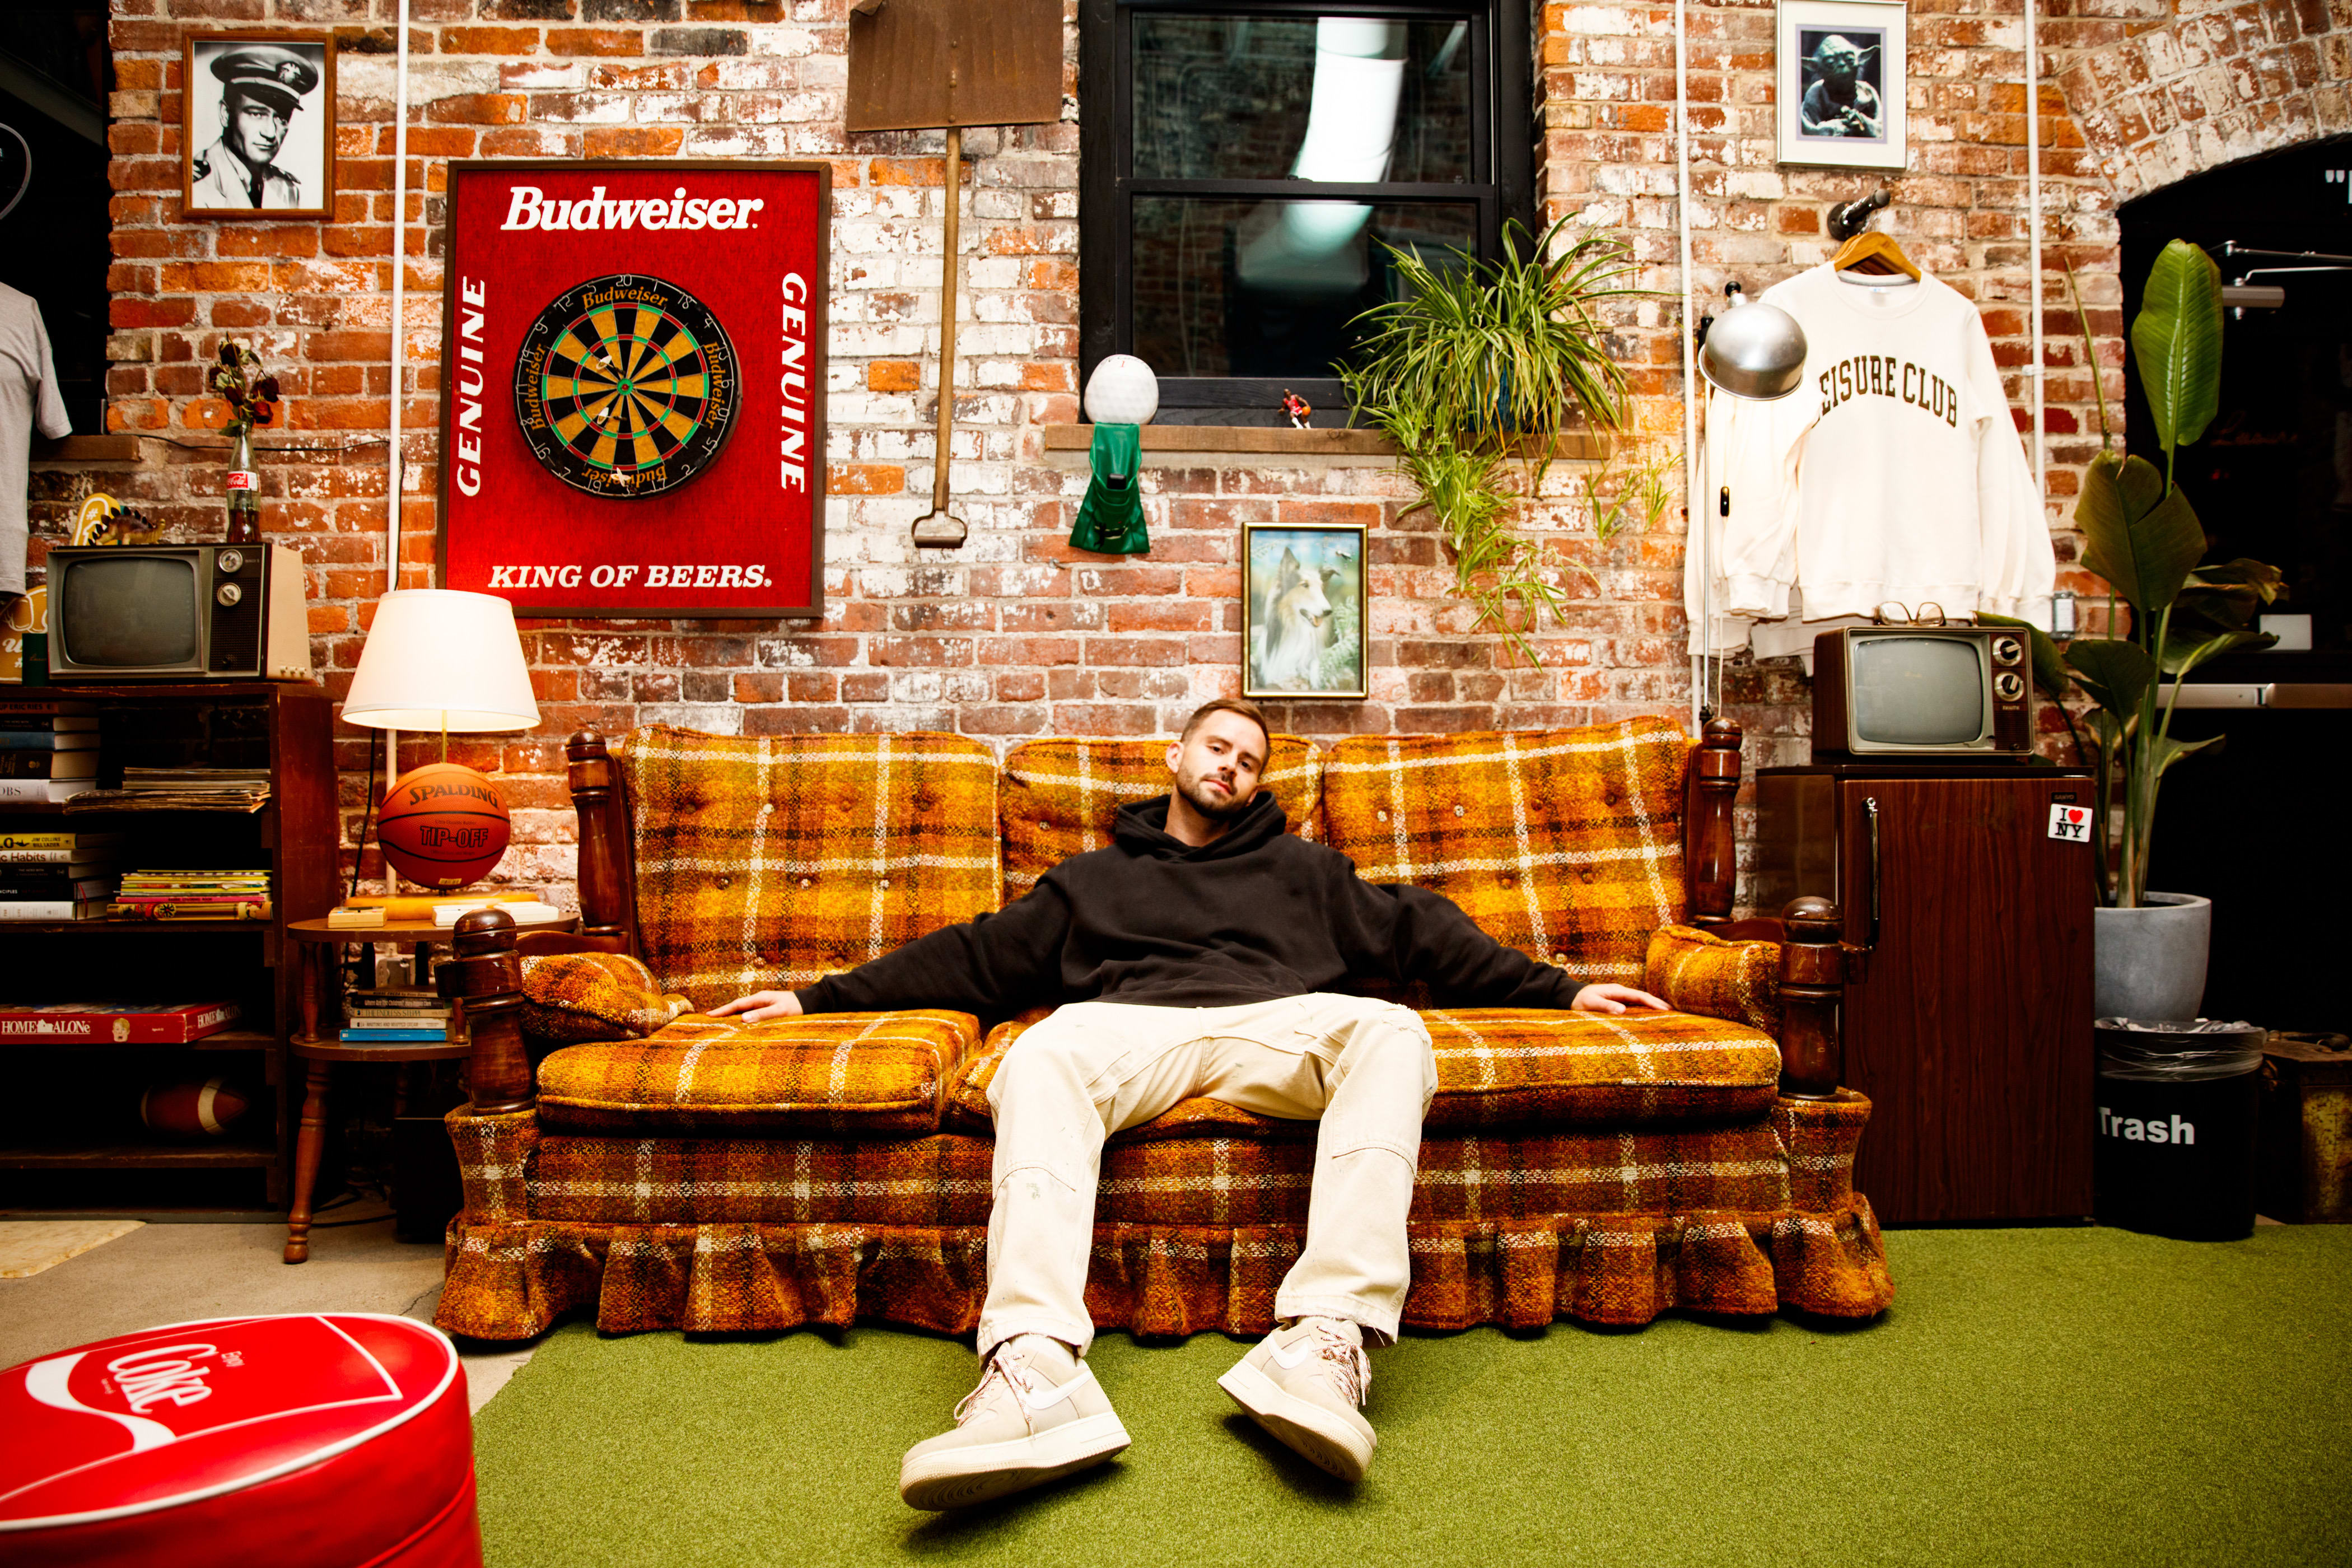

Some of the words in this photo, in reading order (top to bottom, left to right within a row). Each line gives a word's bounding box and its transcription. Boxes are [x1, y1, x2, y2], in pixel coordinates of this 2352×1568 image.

[615, 274, 633, 287] 20
[581, 286, 669, 309] Budweiser
[456, 276, 486, 497] GENUINE
[524, 343, 547, 431] Budweiser
[703, 342, 728, 430] Budweiser
[781, 272, 808, 493] GENUINE
[1812, 354, 1896, 428] EISURE
[1903, 362, 1958, 428] CLUB
[488, 564, 582, 589] KING
[590, 564, 638, 589] OF
[409, 783, 498, 809] SPALDING
[2059, 808, 2068, 821] I
[419, 825, 489, 848] TIP-OFF
[2055, 822, 2084, 838] NY
[11, 851, 46, 862] Habits
[1, 1020, 38, 1033] HOME
[197, 1010, 217, 1028] HOME
[2097, 1107, 2196, 1145] Trash
[107, 1343, 220, 1415] Coke
